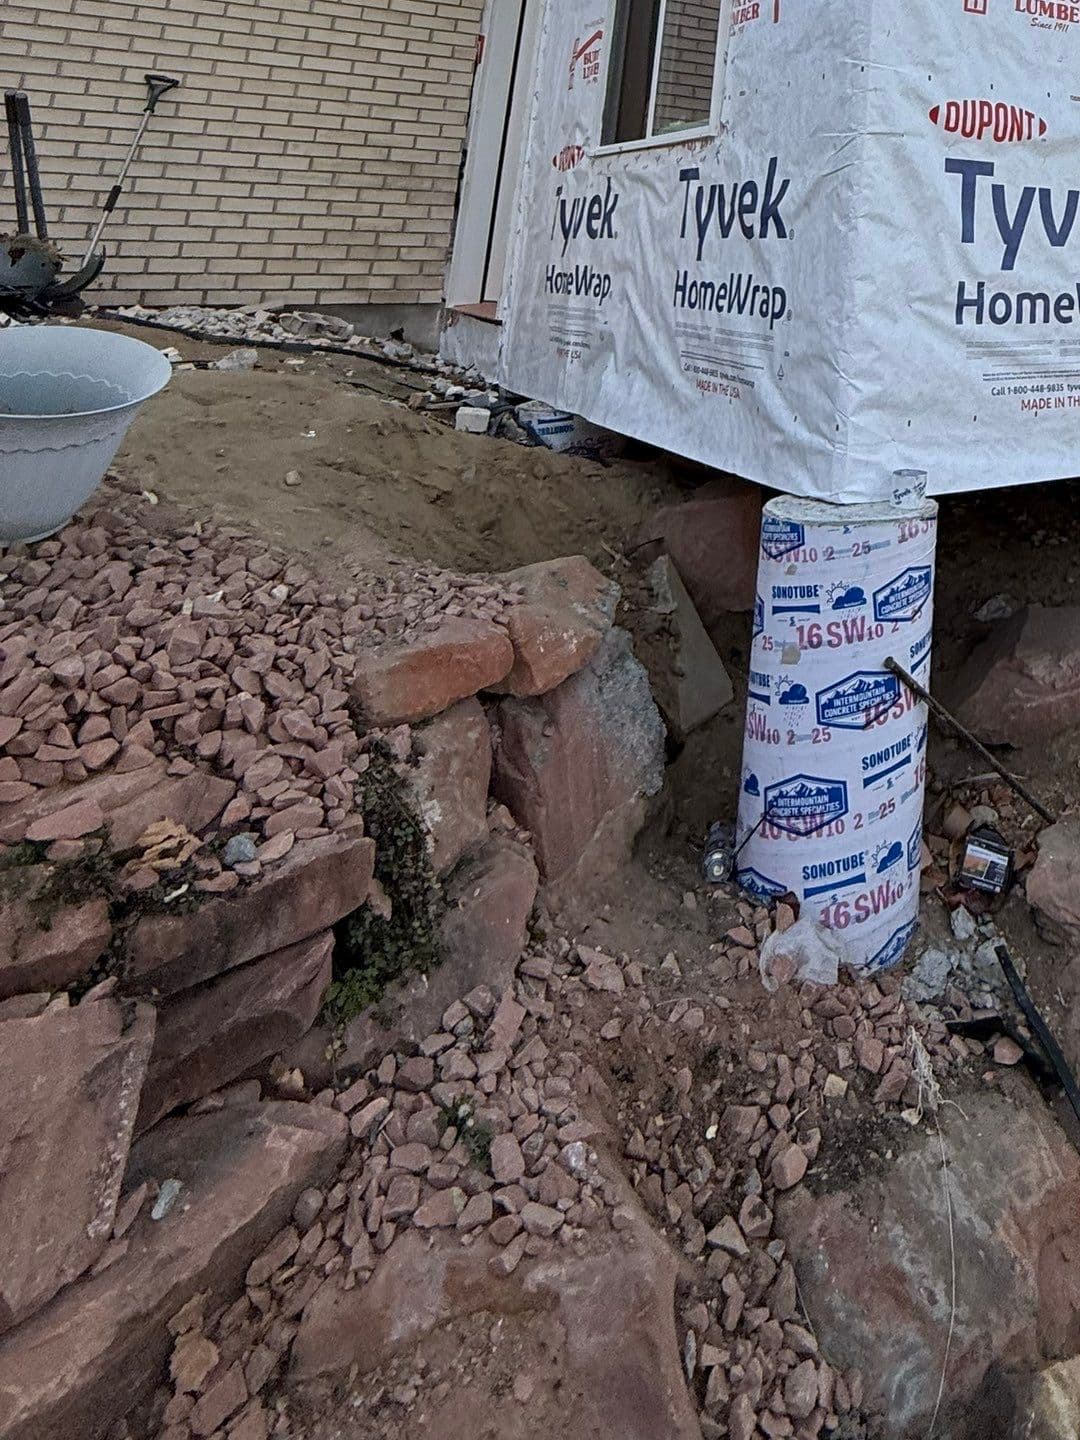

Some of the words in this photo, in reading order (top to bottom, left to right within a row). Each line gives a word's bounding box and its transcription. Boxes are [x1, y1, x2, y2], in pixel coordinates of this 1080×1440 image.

[1031, 18, 1052, 30] Since
[944, 100, 1035, 143] DUPONT
[679, 157, 791, 261] Tyvek
[673, 270, 786, 329] HomeWrap
[991, 386, 1005, 396] Call
[1021, 398, 1051, 411] MADE
[1054, 397, 1065, 408] IN
[852, 541, 871, 557] 25
[772, 585, 819, 599] SONOTUBE
[762, 636, 773, 651] 25
[824, 705, 858, 718] CONCRETE
[858, 691, 896, 710] SPECIALTIES
[833, 686, 886, 708] INTERMOUNTAIN
[787, 733, 796, 745] 2
[812, 727, 831, 745] 25
[862, 736, 912, 771] SONOTUBE
[769, 805, 799, 817] CONCRETE
[800, 801, 840, 816] SPECIALTIES
[778, 795, 830, 806] INTERMOUNTAIN
[853, 813, 863, 830] 2
[879, 798, 896, 819] 25
[802, 851, 865, 881] SONOTUBE
